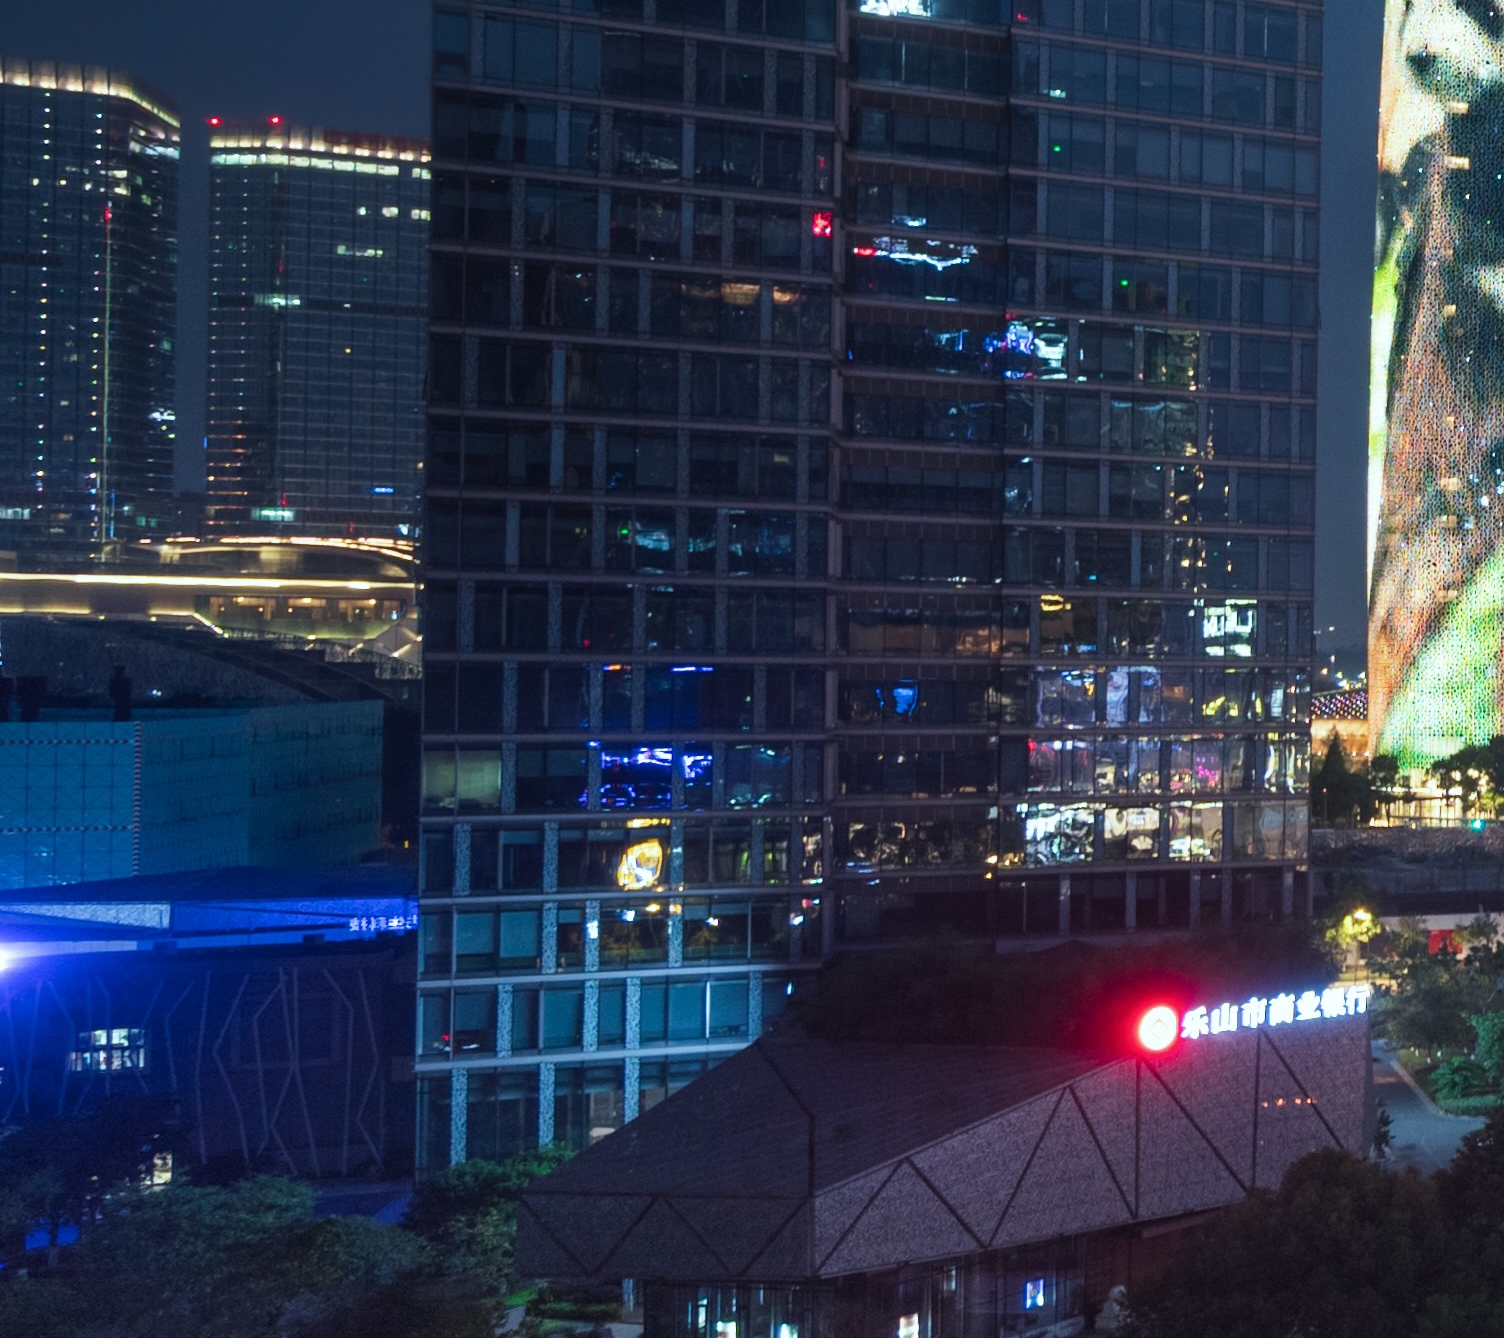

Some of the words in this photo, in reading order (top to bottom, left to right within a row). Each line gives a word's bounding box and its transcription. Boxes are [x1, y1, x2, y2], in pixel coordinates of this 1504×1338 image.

[1180, 984, 1371, 1040] 乐山市商业银行
